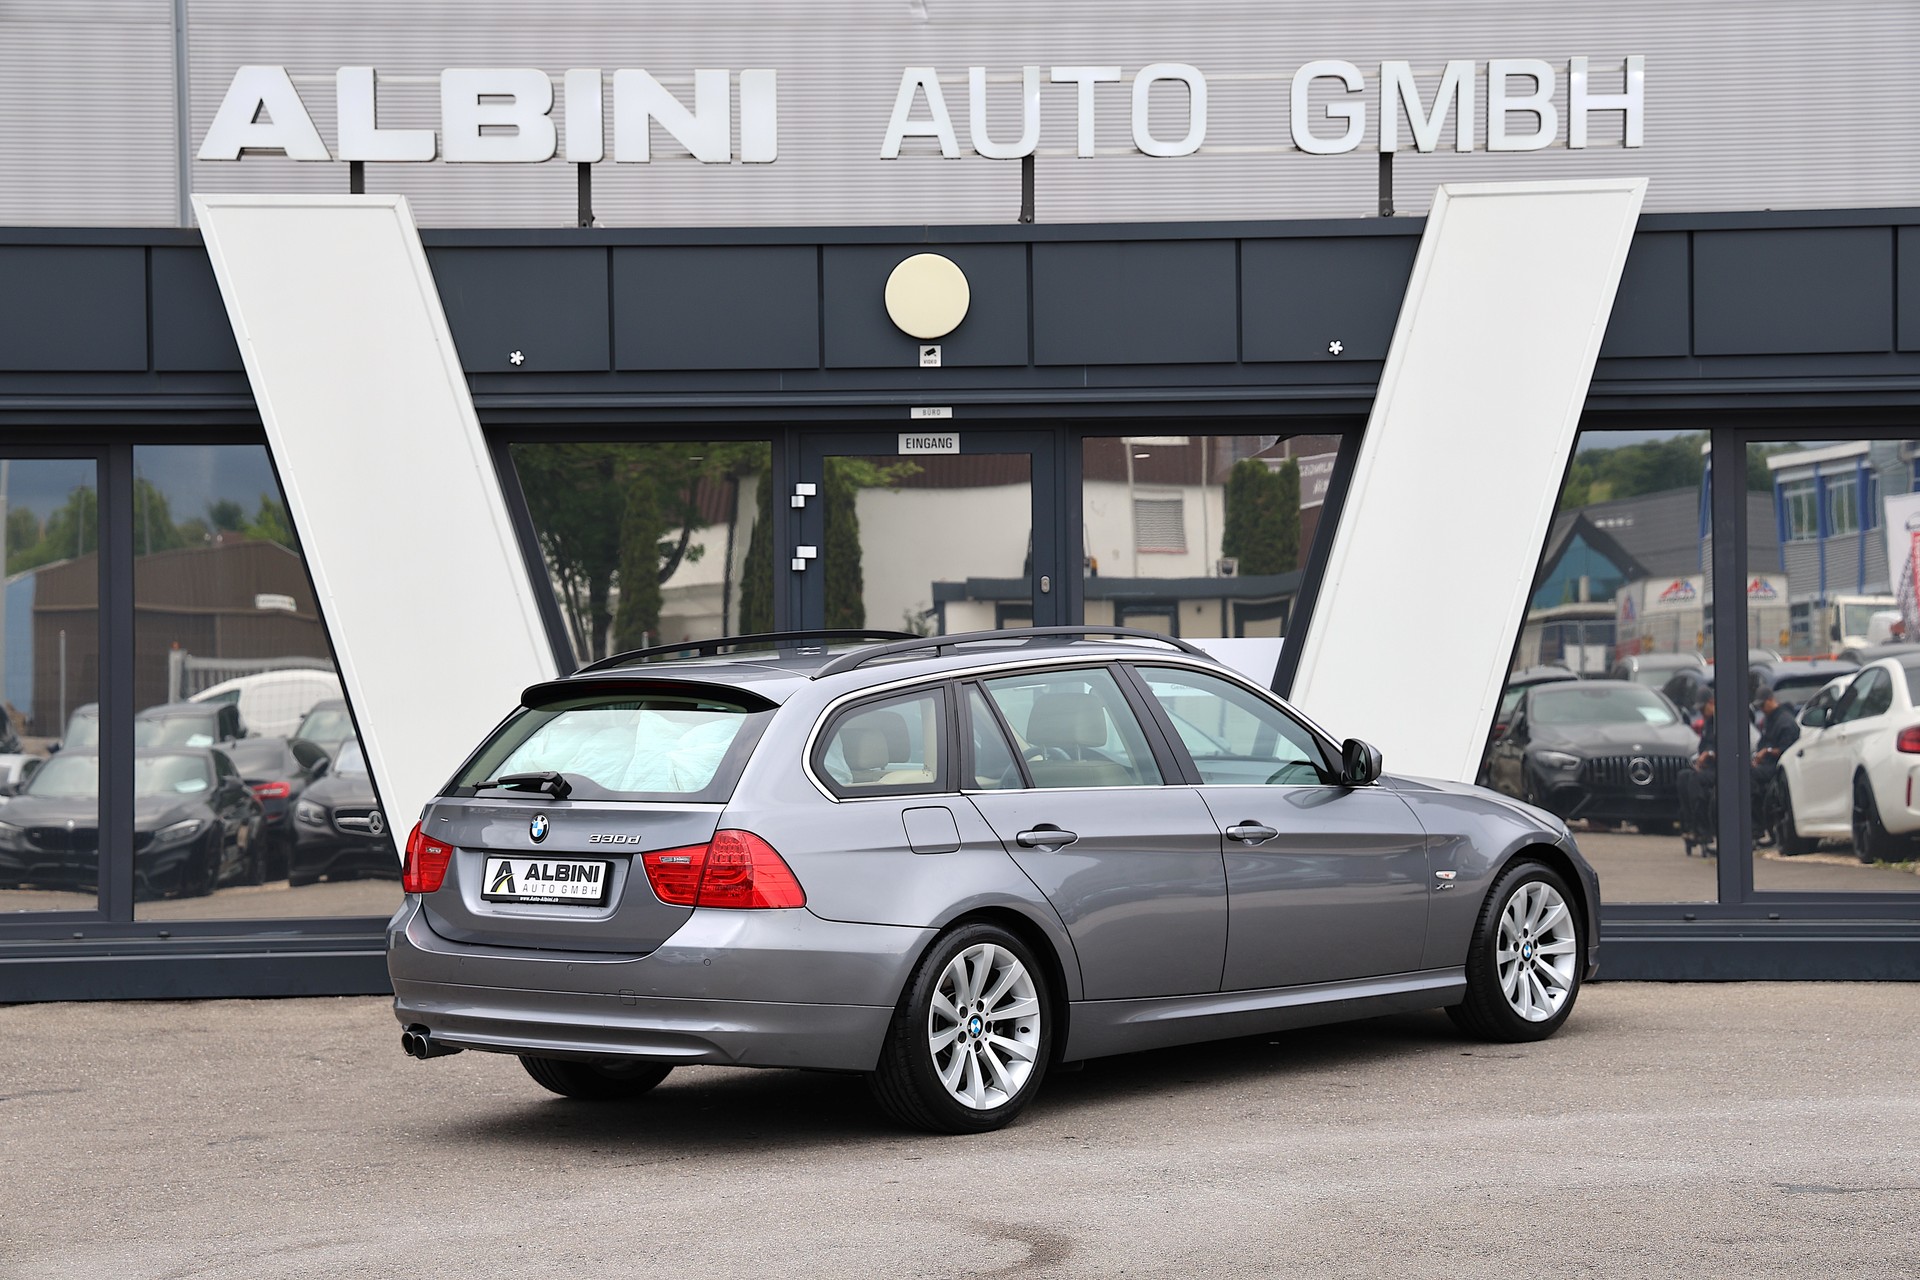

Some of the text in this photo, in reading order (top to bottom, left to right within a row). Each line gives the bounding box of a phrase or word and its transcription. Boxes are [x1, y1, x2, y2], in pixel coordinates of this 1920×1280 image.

[197, 55, 1645, 164] ALBINI AUTO GMBH
[922, 408, 941, 416] BÜRO
[905, 437, 953, 449] EINGANG
[588, 834, 642, 844] 330d
[524, 863, 600, 883] ALBINI
[522, 884, 598, 895] AUTO GMBH
